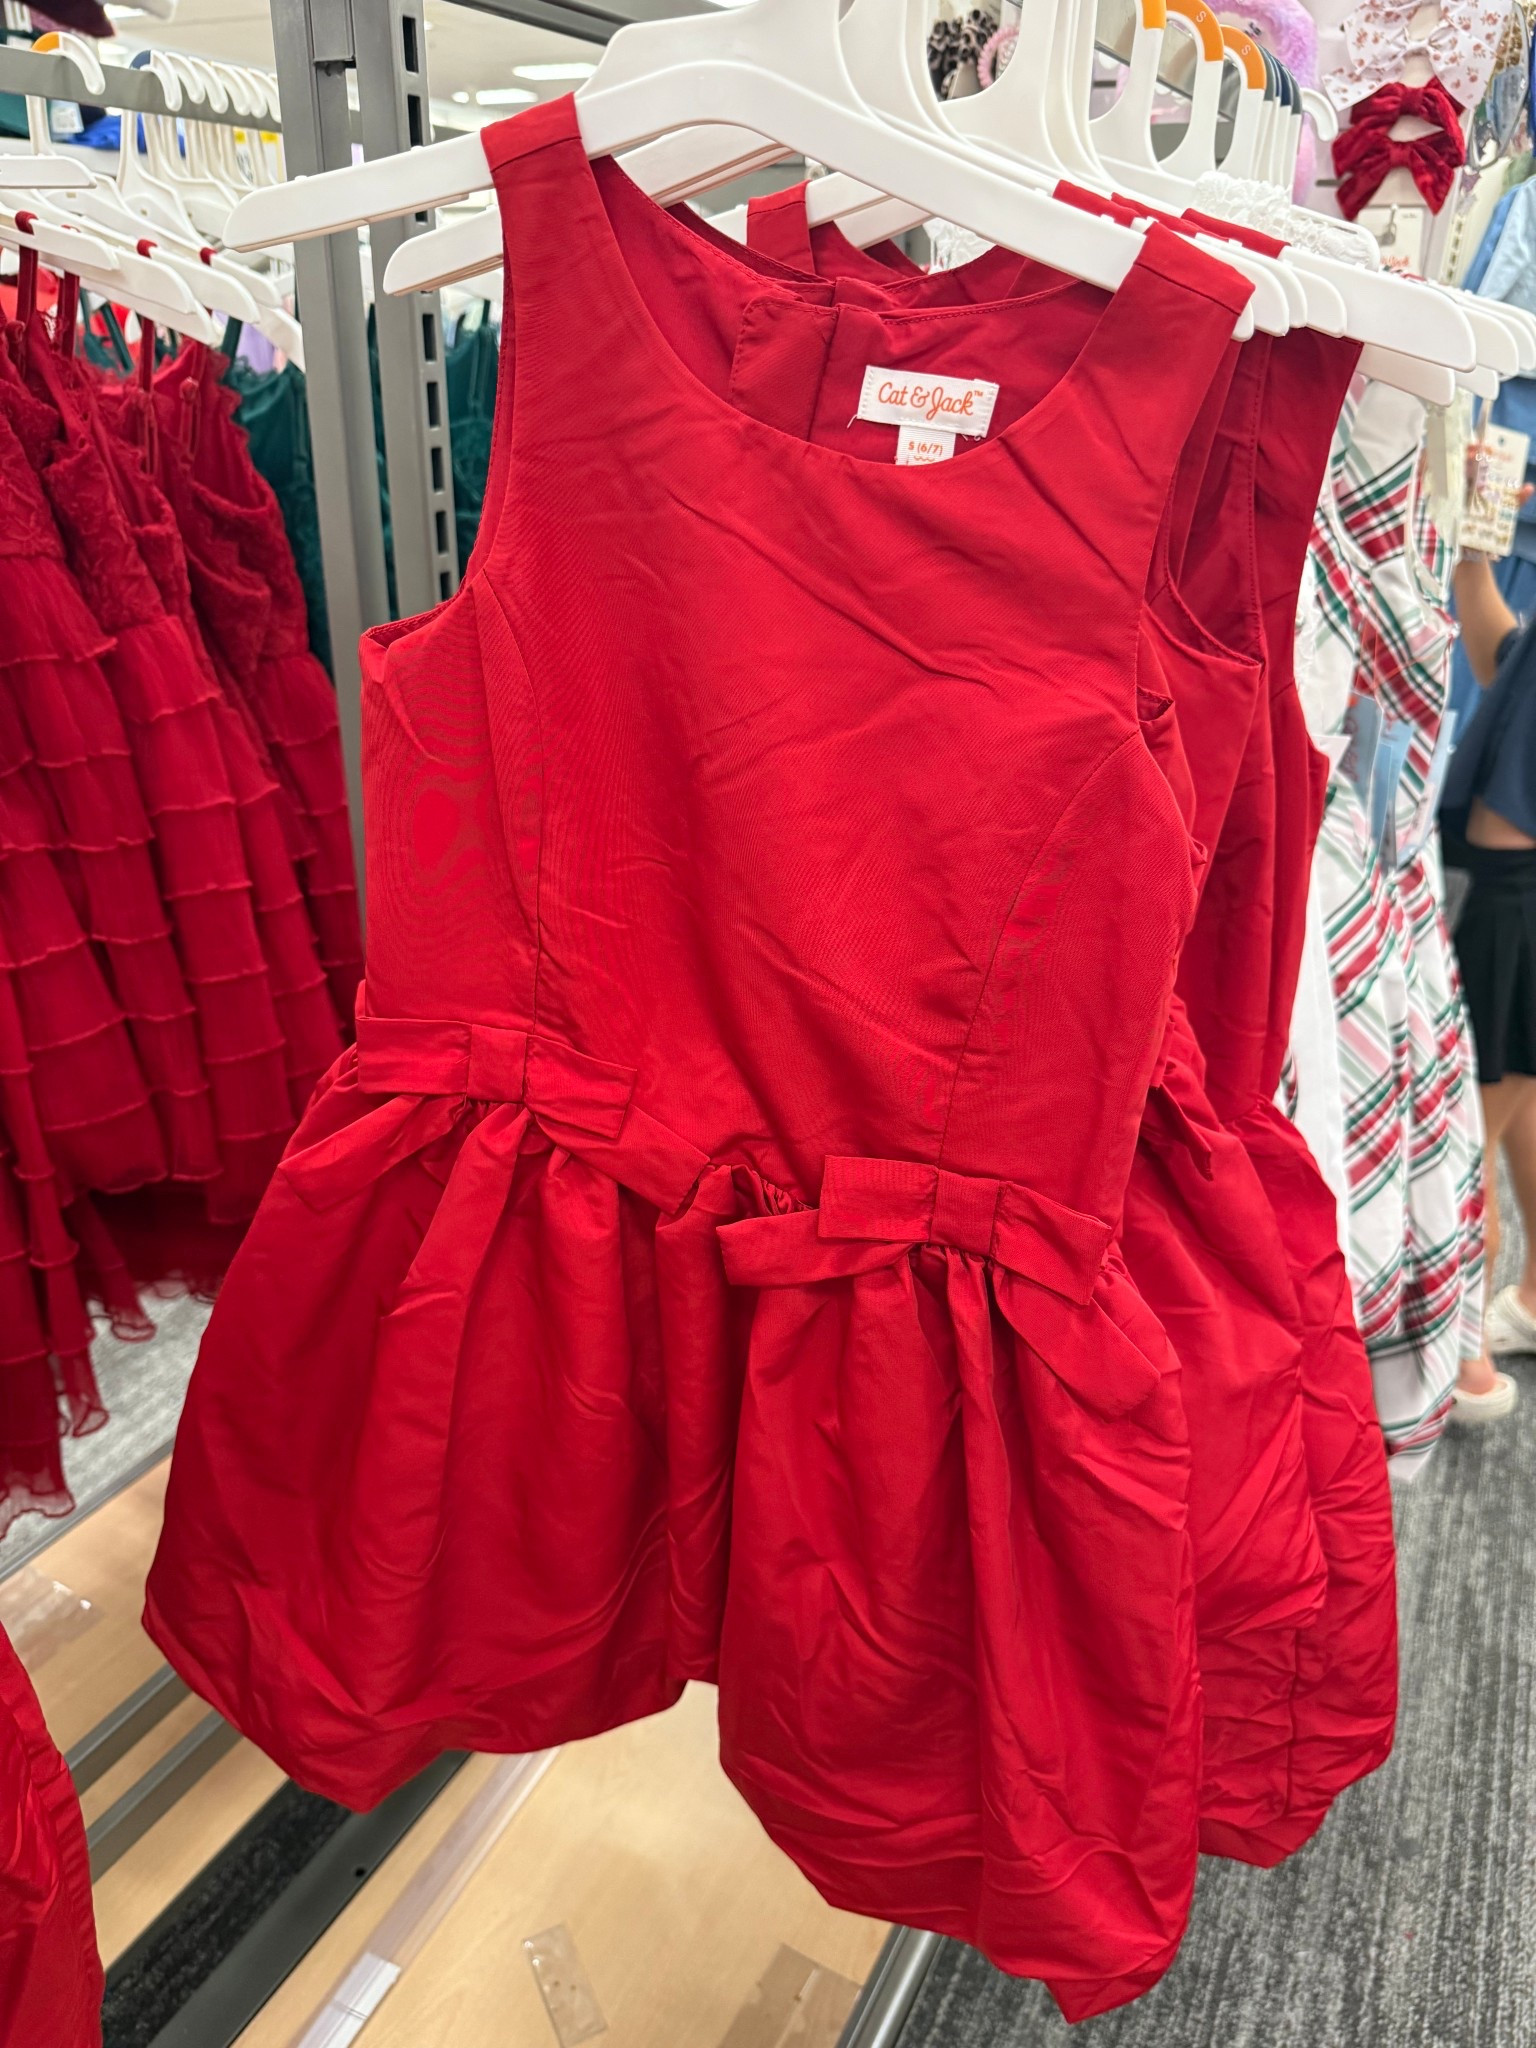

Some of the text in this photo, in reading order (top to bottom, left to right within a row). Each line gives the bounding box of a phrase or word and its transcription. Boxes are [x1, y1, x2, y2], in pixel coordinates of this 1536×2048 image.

[1196, 10, 1207, 23] S
[1241, 44, 1251, 56] S
[878, 381, 908, 406] Cat
[910, 386, 930, 408] &
[908, 441, 943, 456] S (6/7)
